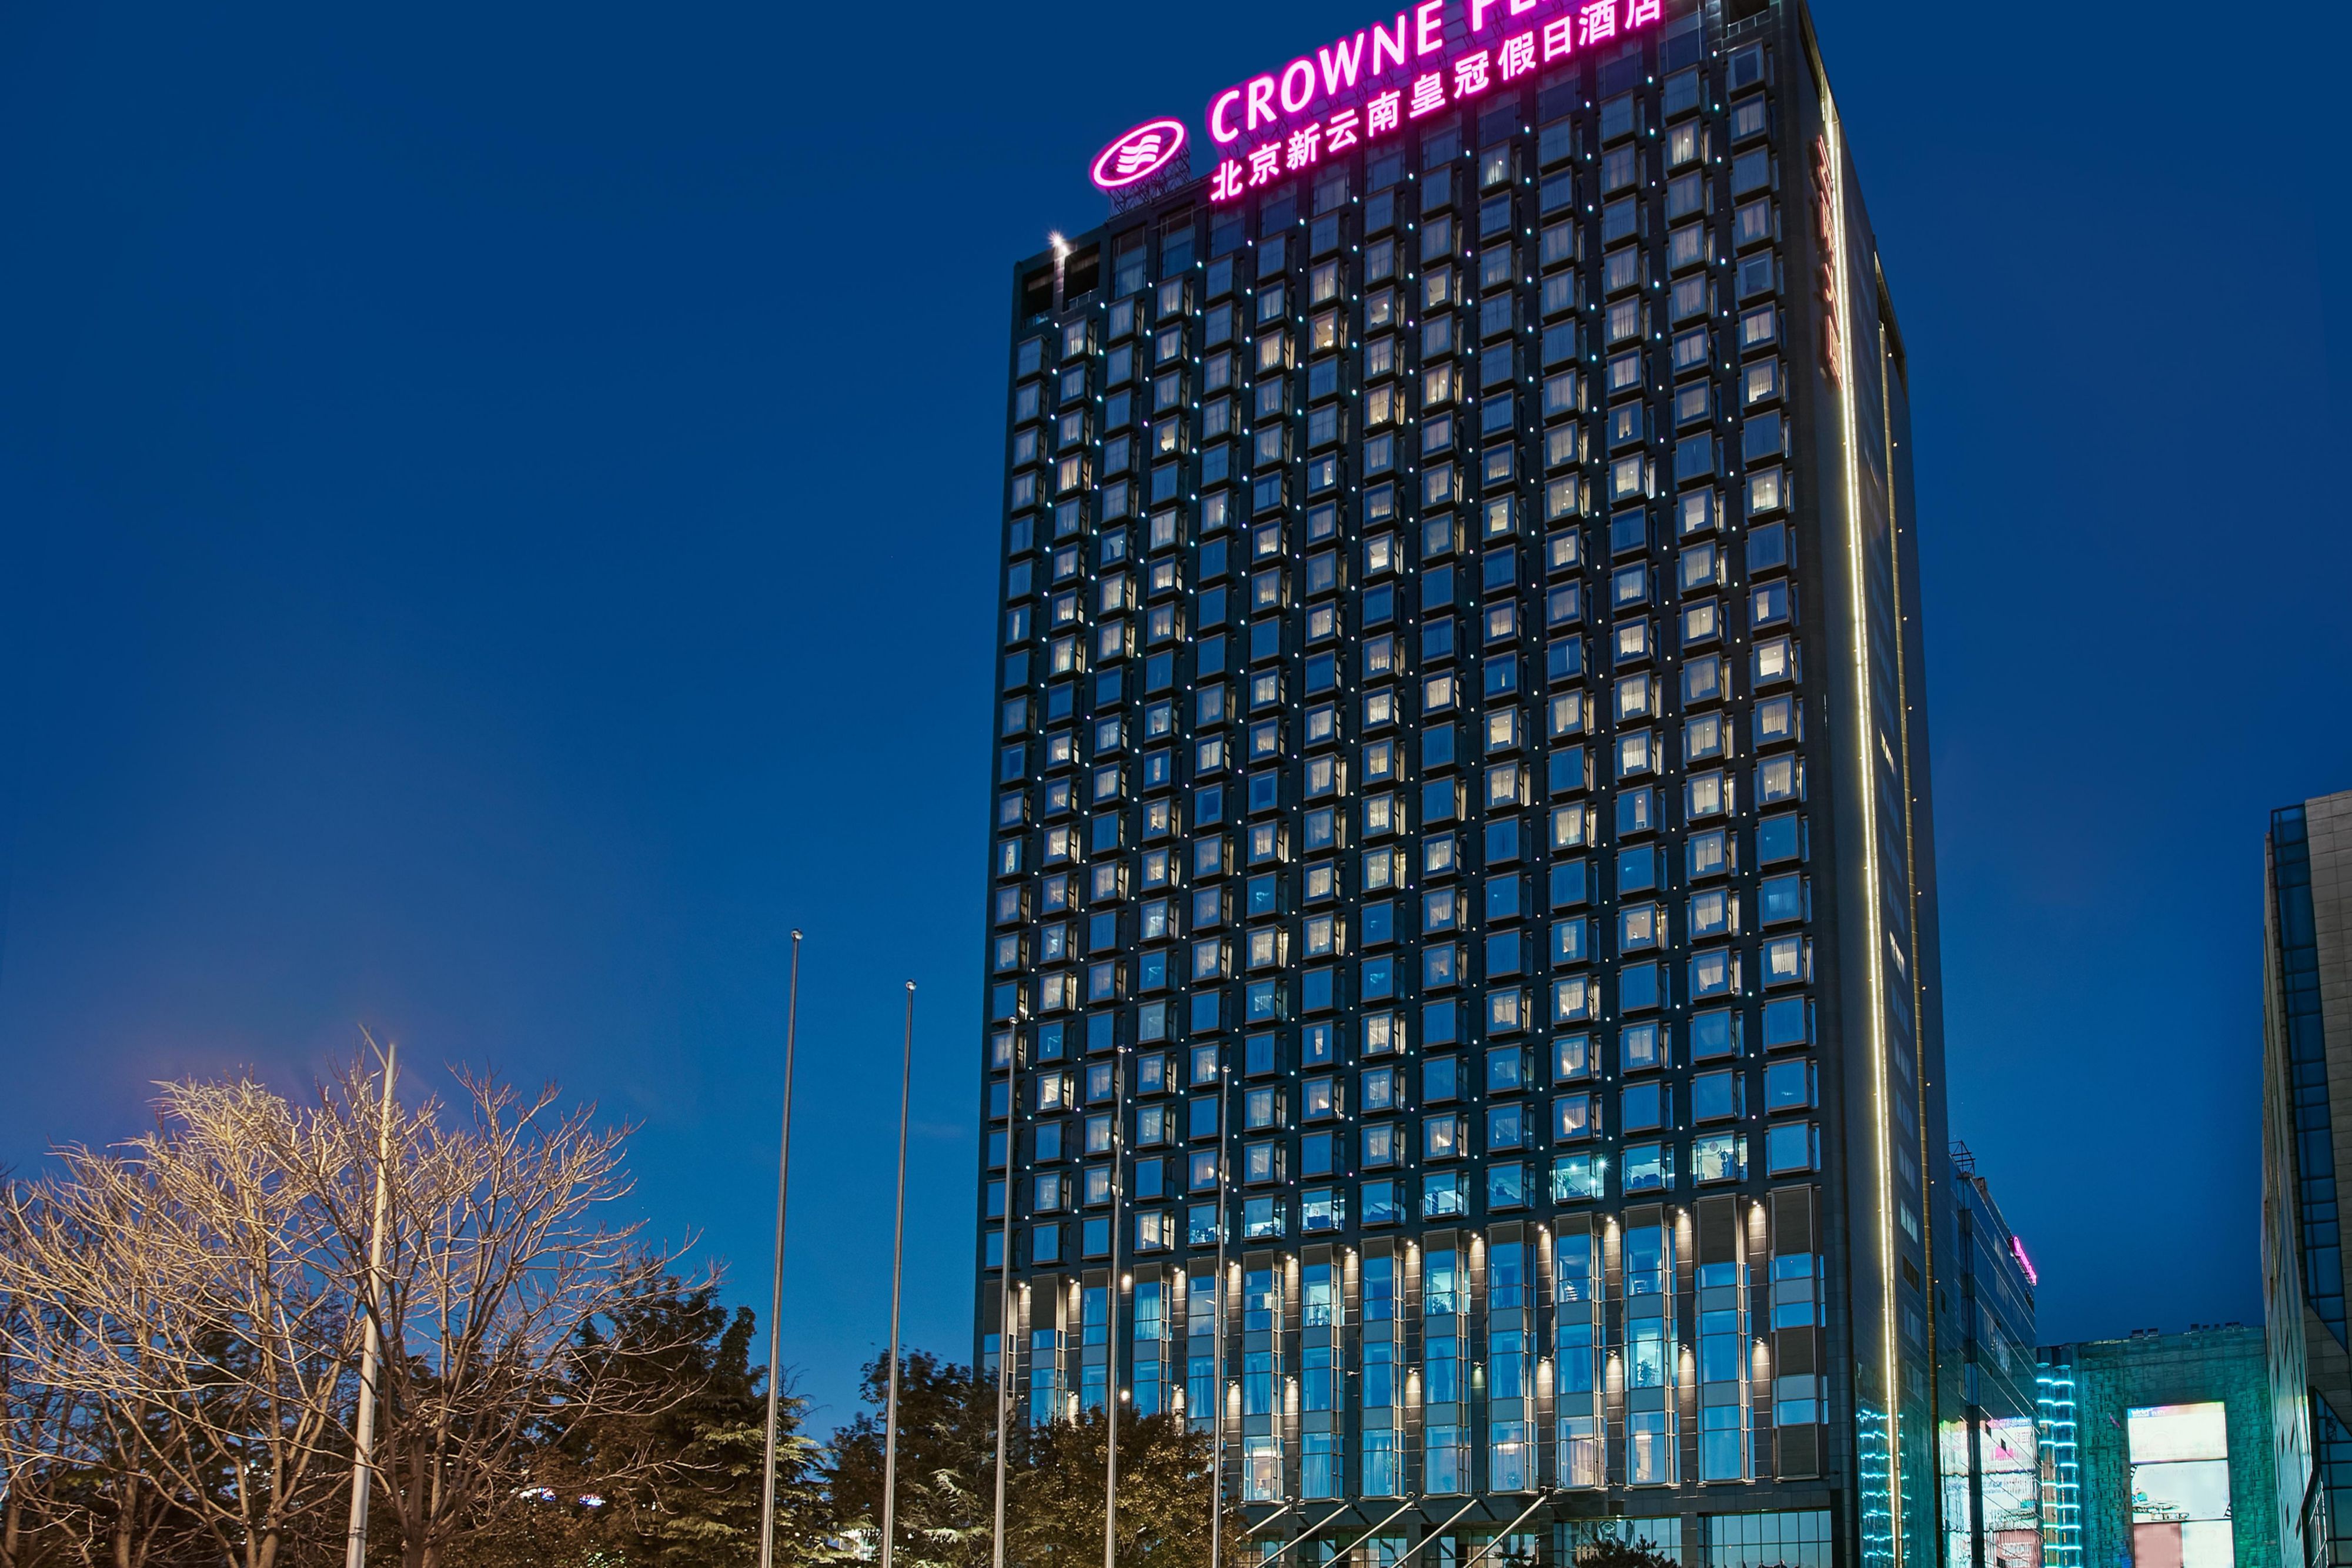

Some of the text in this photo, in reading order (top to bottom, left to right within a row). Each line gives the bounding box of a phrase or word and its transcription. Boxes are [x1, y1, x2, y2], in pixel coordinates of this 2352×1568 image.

[1210, 0, 1660, 201] 北京新云南皇冠假日酒店
[1211, 0, 1443, 143] CROWNE
